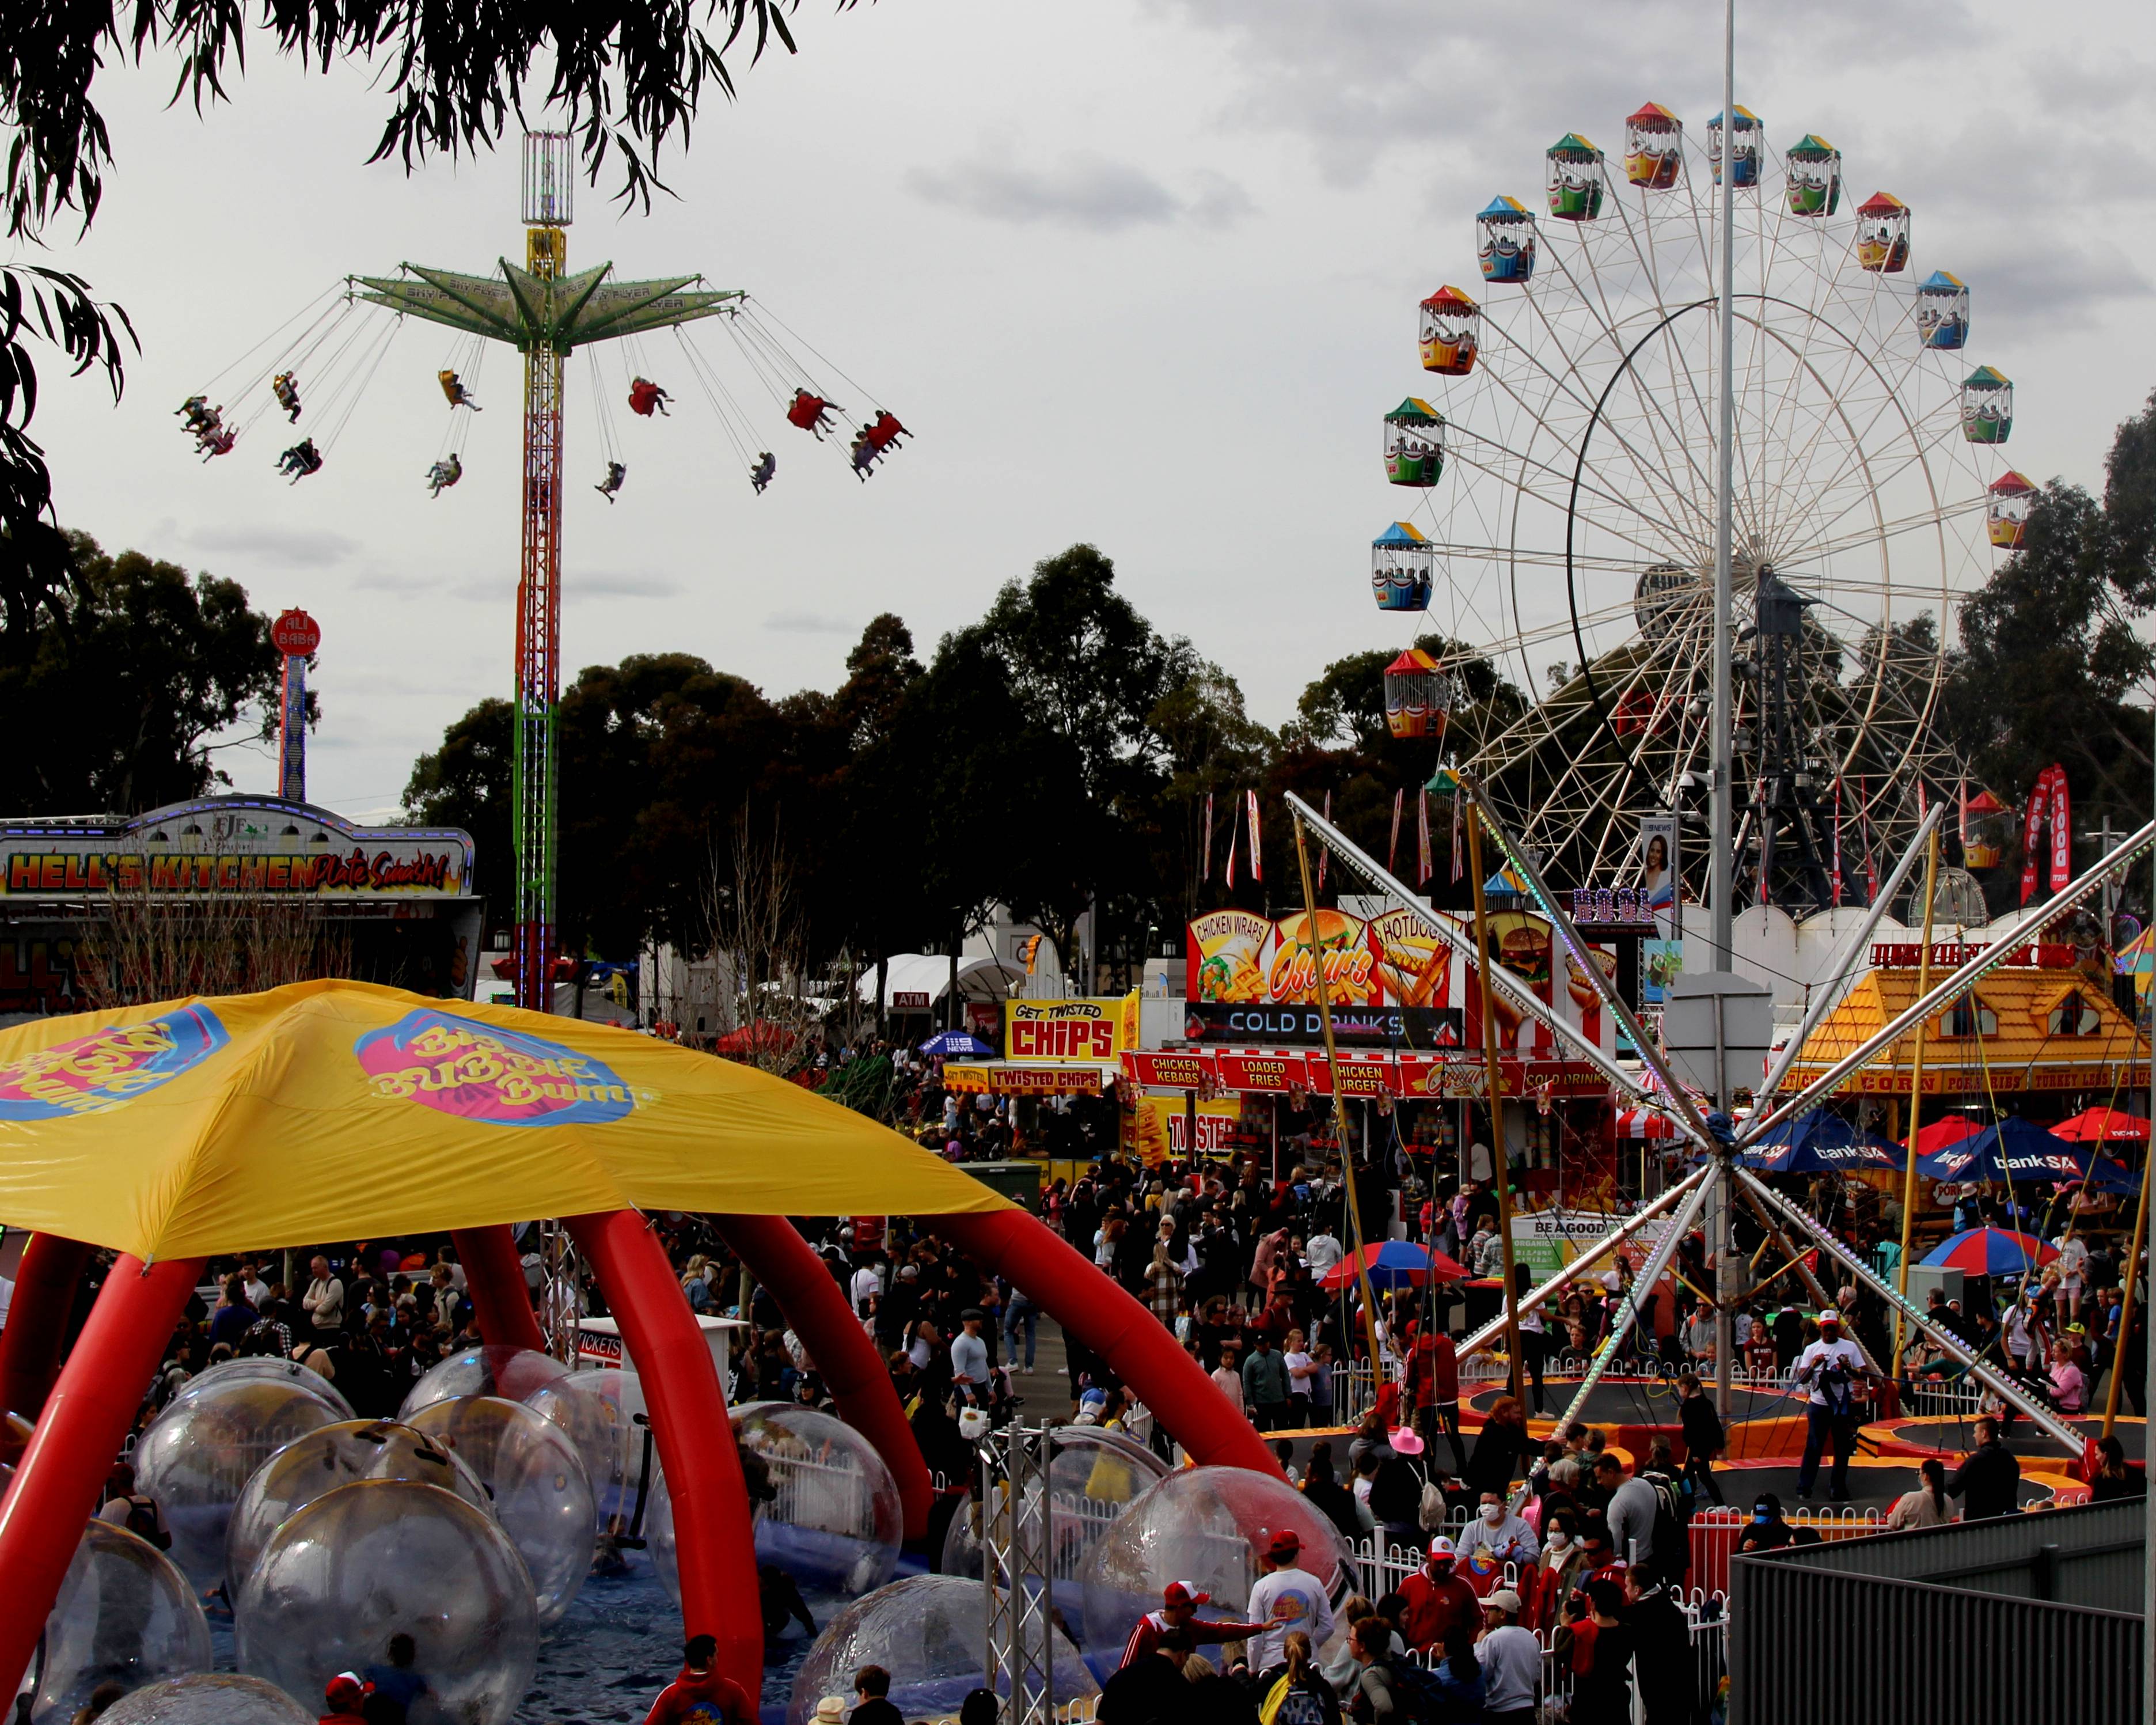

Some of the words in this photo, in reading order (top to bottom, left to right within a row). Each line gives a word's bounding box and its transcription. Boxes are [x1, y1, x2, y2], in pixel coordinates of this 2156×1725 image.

[286, 616, 308, 630] ALI
[279, 632, 317, 645] BABA
[9, 854, 145, 891] HELL'S
[150, 854, 318, 891] KITCHEN
[312, 847, 369, 890] Plate
[371, 851, 450, 890] Smash!
[1197, 915, 1232, 943] CHICKEN
[1234, 915, 1265, 943] WRAPS
[1268, 935, 1374, 1003] Oscar's
[899, 994, 925, 1006] ATM
[1015, 1004, 1044, 1020] GET
[1048, 1004, 1103, 1019] TWISTED
[1229, 1012, 1296, 1033] COLD
[410, 1025, 506, 1057] Big
[1151, 1057, 1200, 1071] CHICKEN
[1241, 1060, 1286, 1074] LOADED
[947, 1070, 958, 1081] GET
[1156, 1070, 1200, 1085] KEBABS
[1337, 1066, 1383, 1079] HICKEN
[1527, 1074, 1559, 1086] COLD
[1563, 1073, 1610, 1086] DRINKS
[1249, 1074, 1282, 1087] FRIES
[1339, 1079, 1384, 1092] URGER
[1861, 1077, 1935, 1091] CORN
[1990, 1076, 2021, 1089] RIBS
[2036, 1073, 2078, 1088] TURKEY
[497, 1074, 663, 1110] Bump
[1993, 1154, 2077, 1170] bankSA
[1535, 1222, 1553, 1233] BE
[1554, 1222, 1564, 1233] A
[1566, 1223, 1605, 1234] GOOD
[579, 1332, 621, 1356] TICKETS
